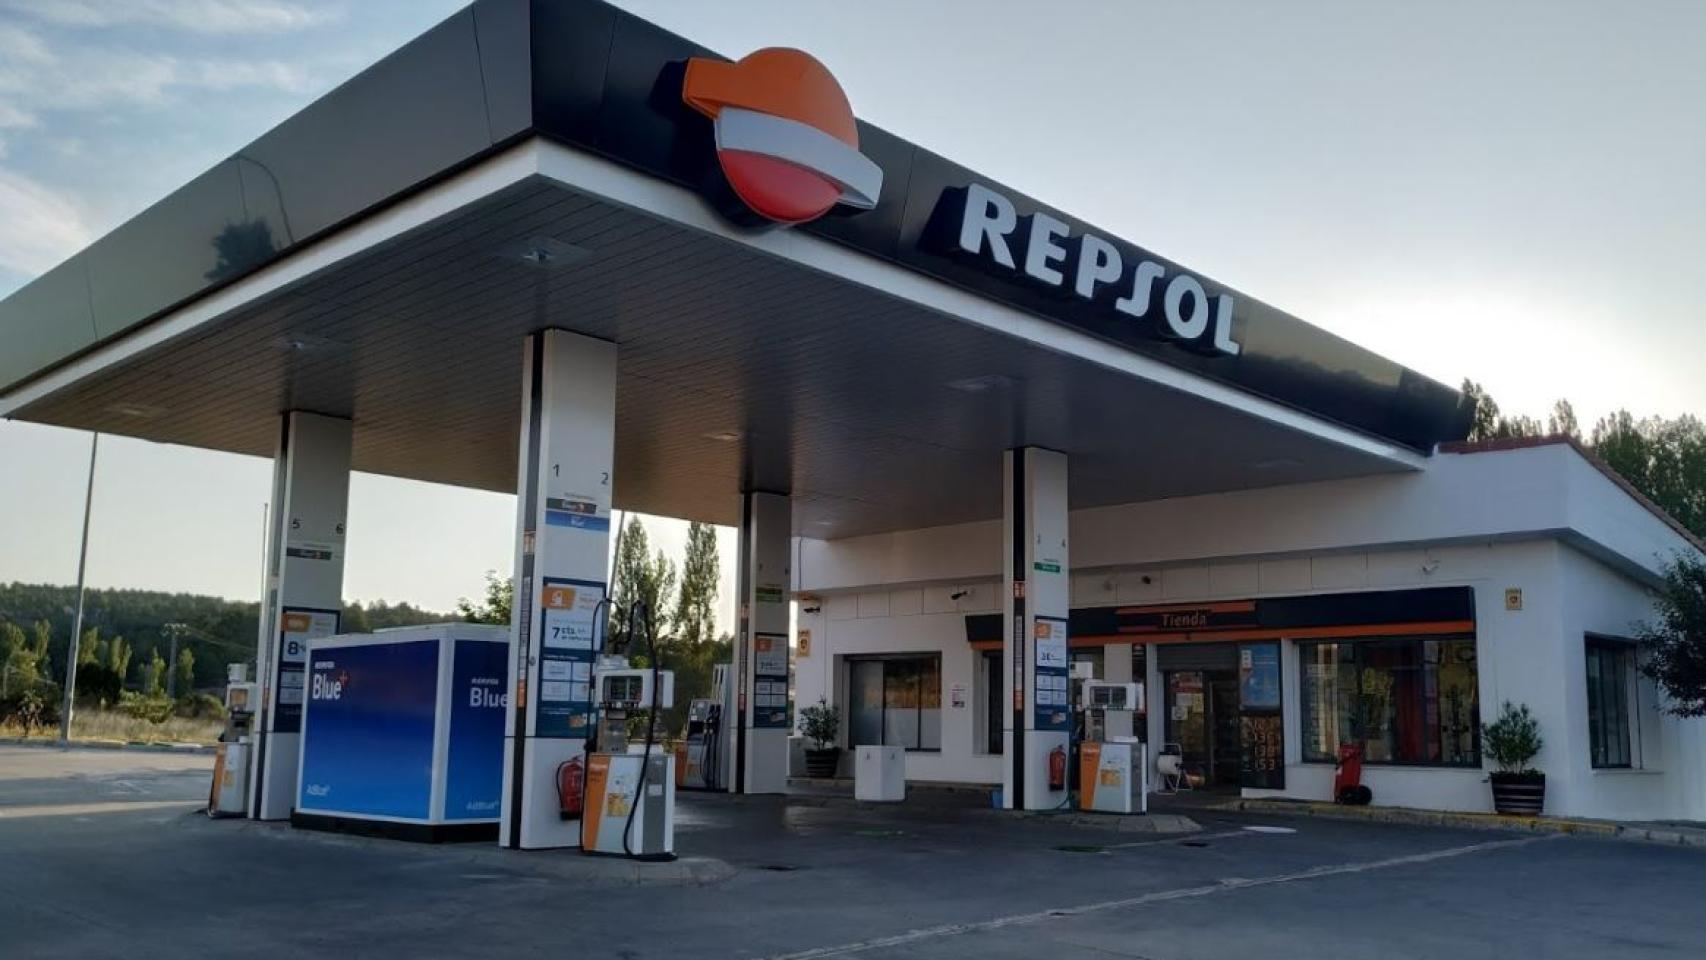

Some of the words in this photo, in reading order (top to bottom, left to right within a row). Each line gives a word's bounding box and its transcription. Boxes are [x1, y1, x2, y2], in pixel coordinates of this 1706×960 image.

[959, 183, 1240, 356] REPSOL
[552, 463, 560, 477] 1
[601, 472, 609, 485] 2
[292, 518, 300, 529] 5
[336, 523, 344, 534] 6
[1162, 608, 1207, 626] Tienda
[552, 626, 560, 638] 7
[288, 641, 298, 655] 8
